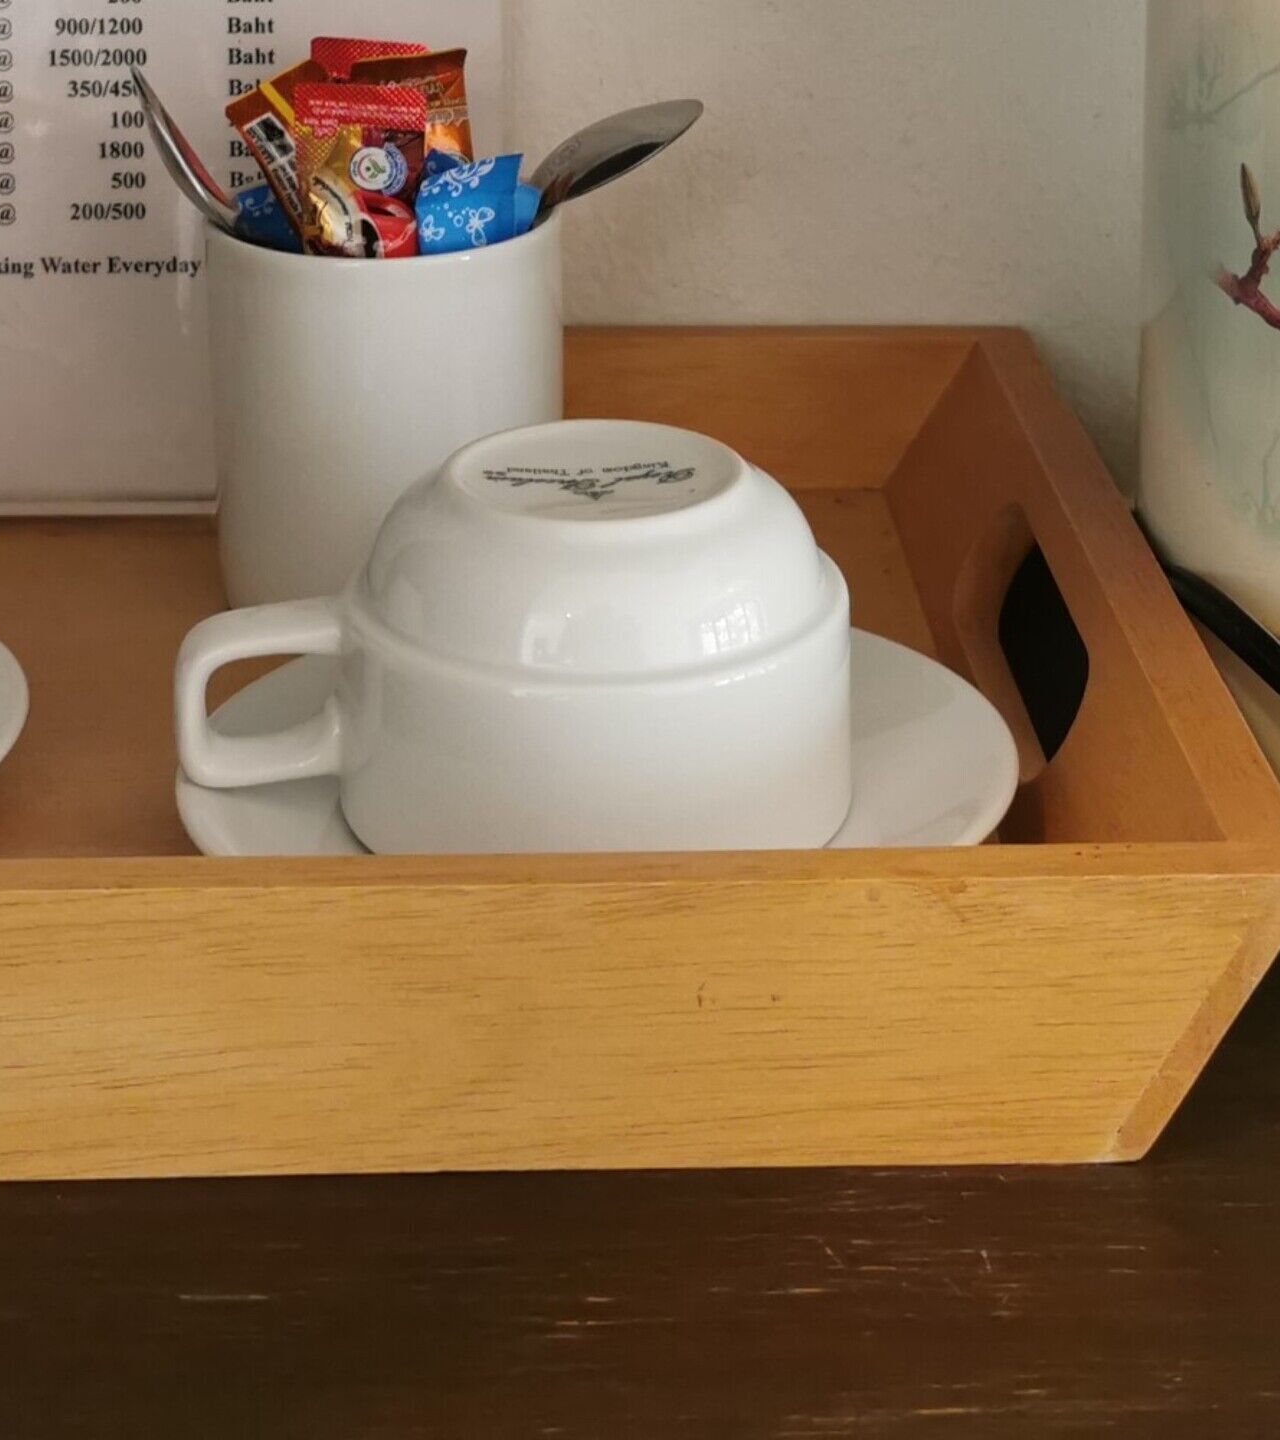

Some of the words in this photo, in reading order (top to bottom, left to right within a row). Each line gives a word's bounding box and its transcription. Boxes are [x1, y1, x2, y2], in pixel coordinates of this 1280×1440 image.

[55, 17, 143, 36] 900/1200
[49, 49, 147, 67] 1500/2000
[228, 48, 275, 65] Baht
[112, 111, 144, 128] 100
[99, 141, 144, 159] 1800
[111, 172, 146, 189] 500
[70, 203, 146, 220] 200/500
[40, 257, 101, 274] Water
[107, 256, 201, 278] Everyday
